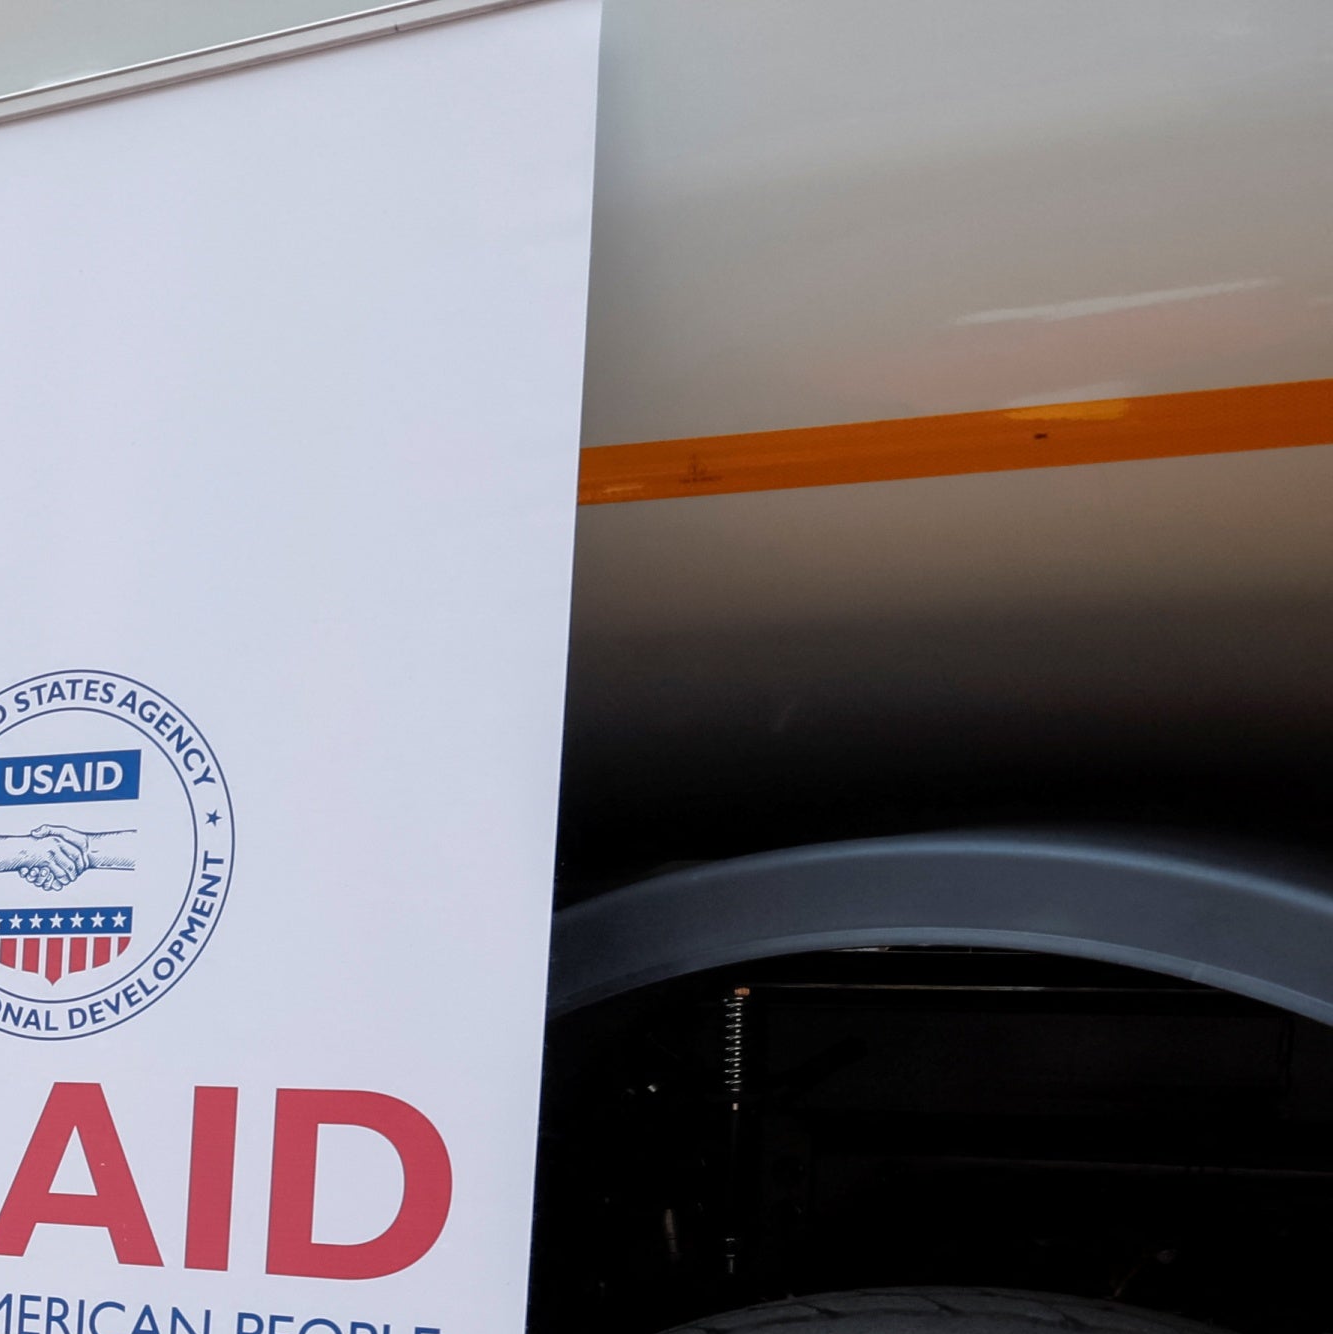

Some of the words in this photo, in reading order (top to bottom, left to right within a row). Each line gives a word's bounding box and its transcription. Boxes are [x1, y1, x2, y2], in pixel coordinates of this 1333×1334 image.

[4, 761, 124, 796] USAID
[14, 679, 117, 713] STATES
[117, 690, 216, 787] AGENCY
[68, 850, 224, 1030] DEVELOPMENT
